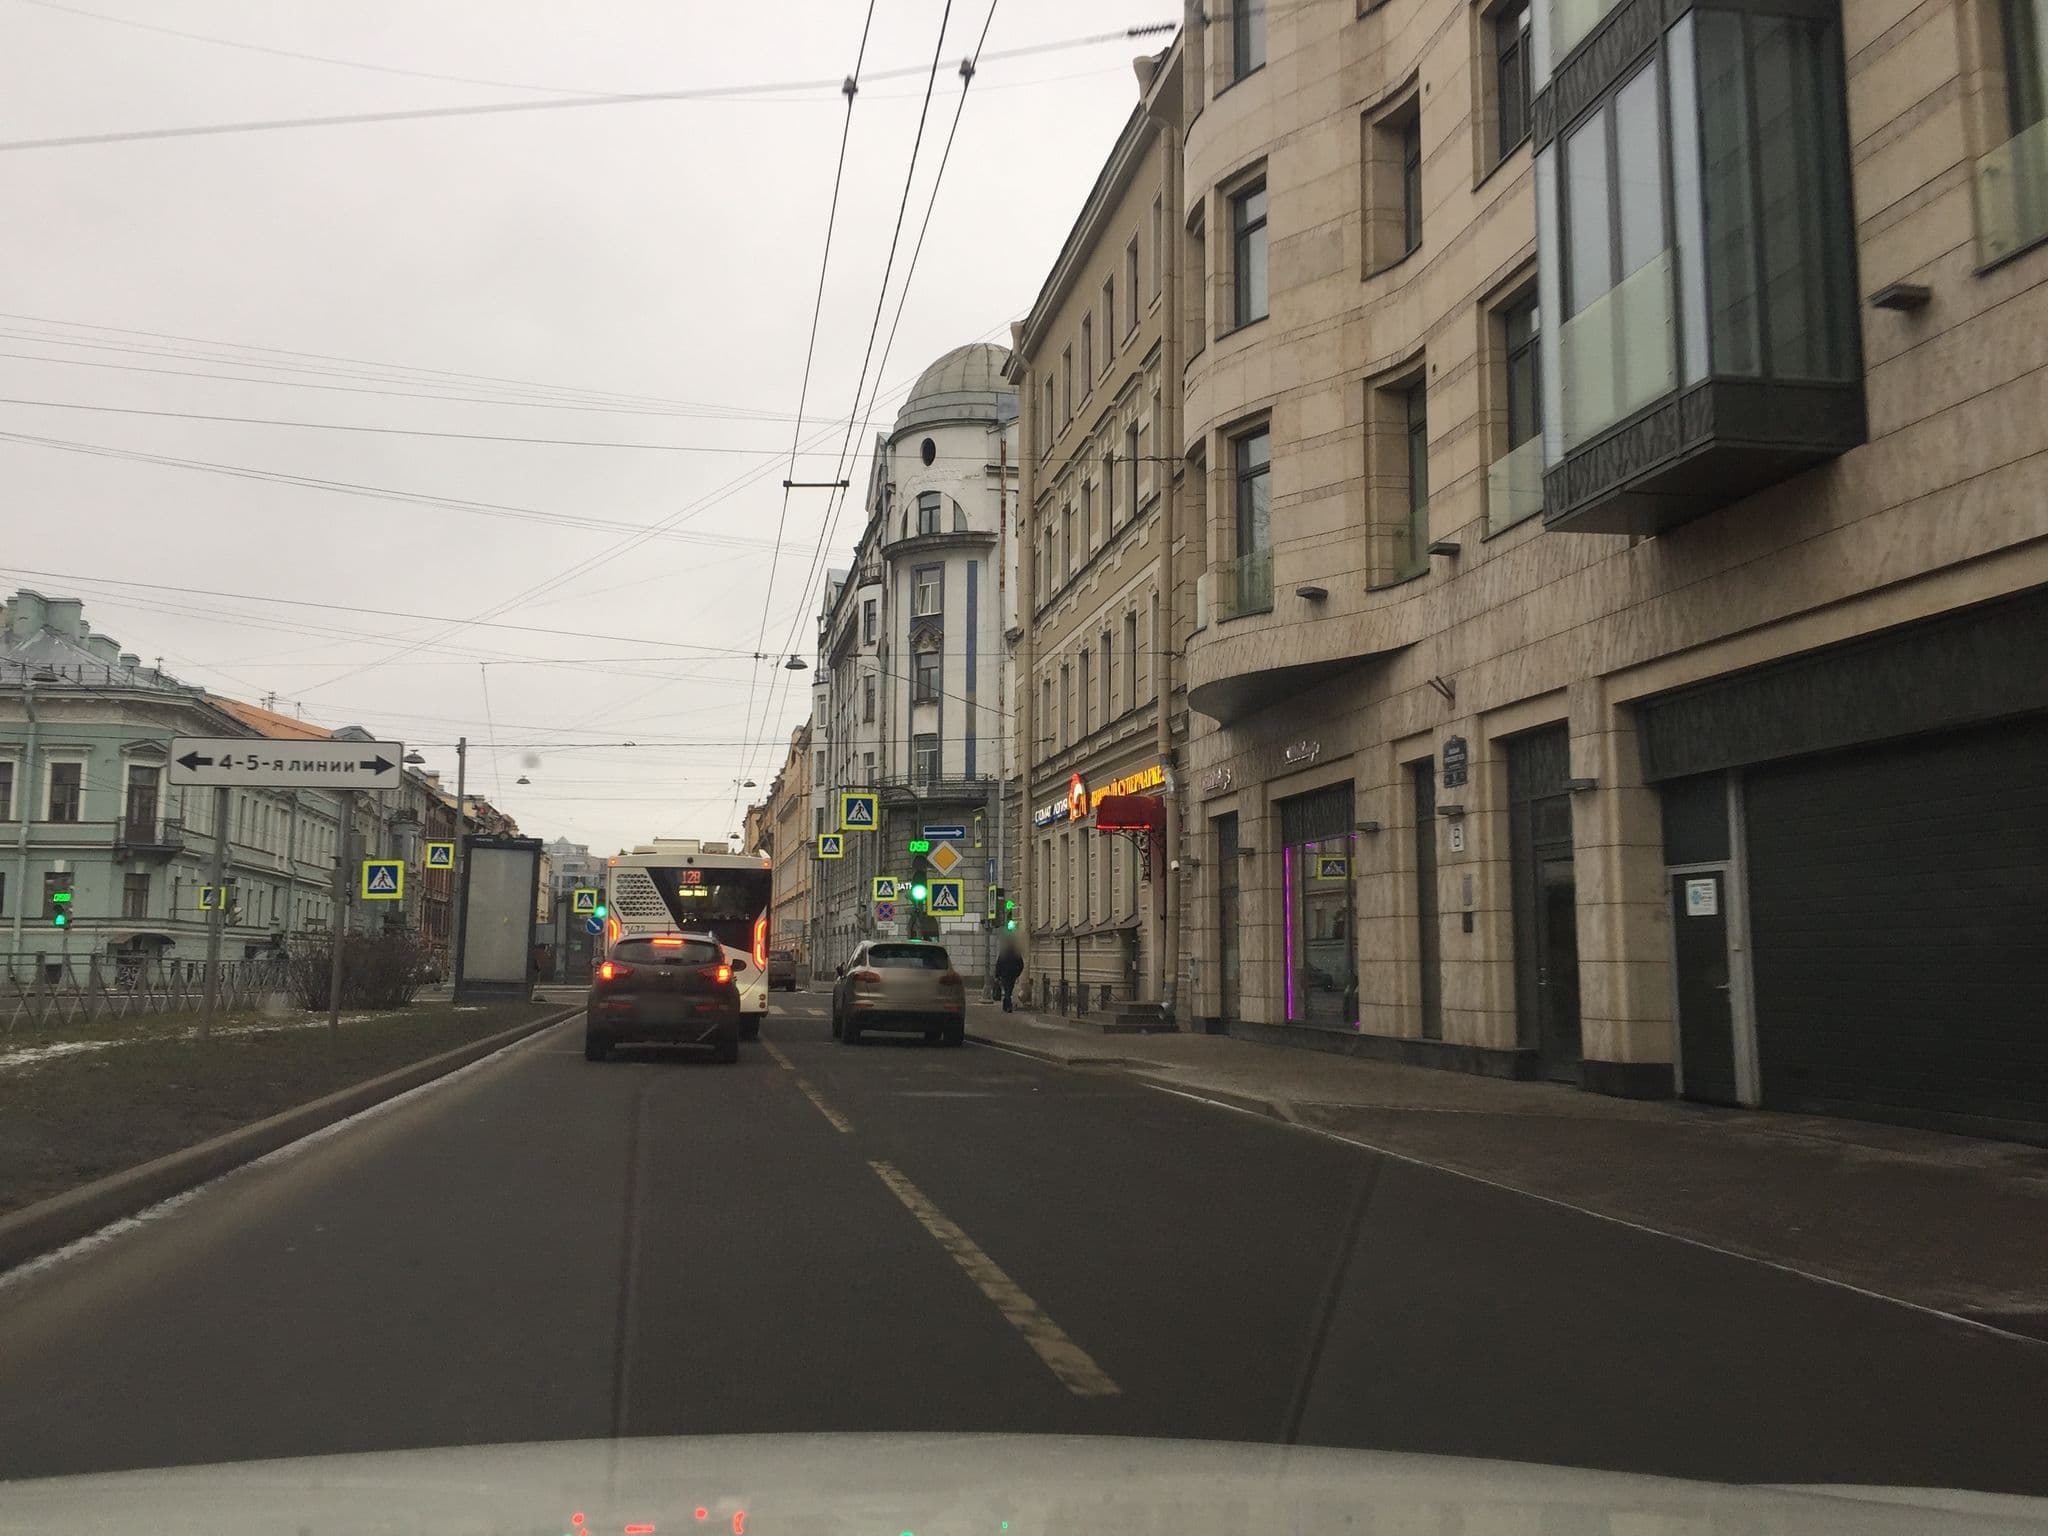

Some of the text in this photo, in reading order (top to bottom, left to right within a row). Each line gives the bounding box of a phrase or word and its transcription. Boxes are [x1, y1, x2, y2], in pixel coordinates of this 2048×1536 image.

[218, 754, 355, 773] 4-5-я линии
[1118, 765, 1166, 796] СУПЕРМАРКЕ
